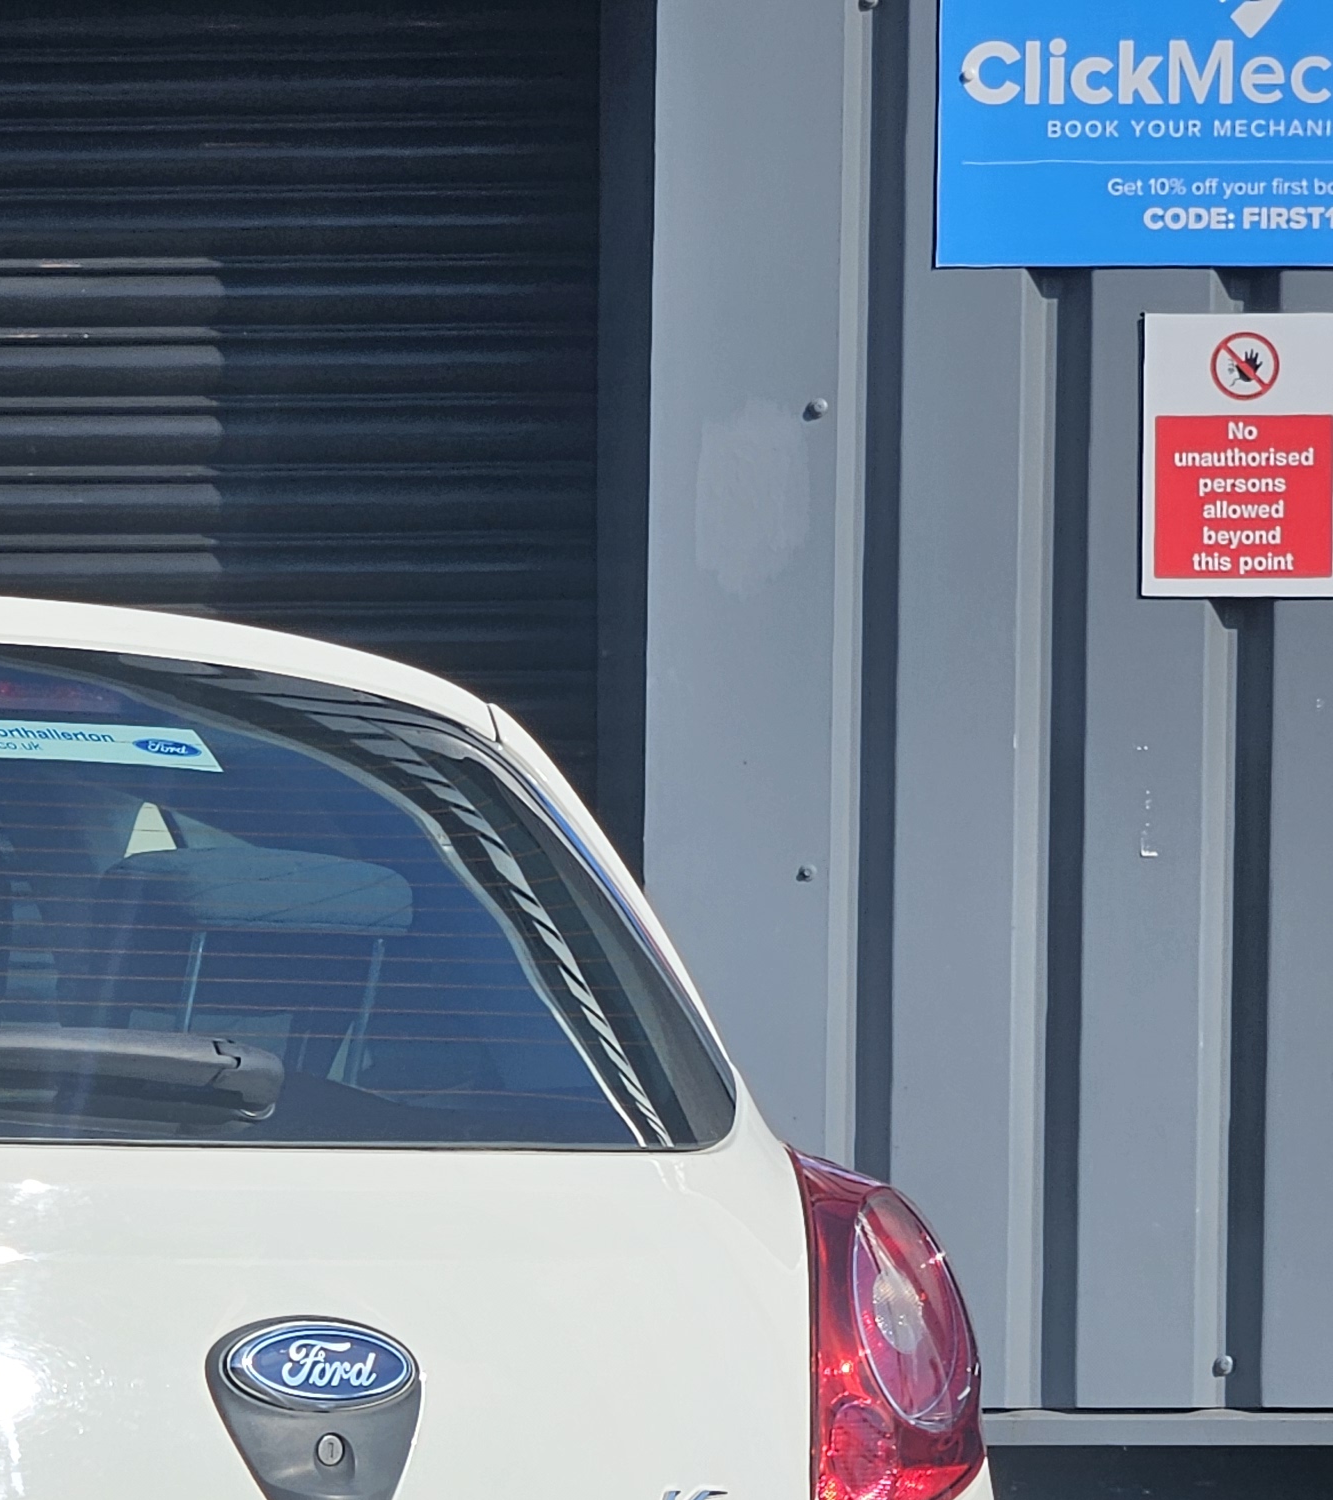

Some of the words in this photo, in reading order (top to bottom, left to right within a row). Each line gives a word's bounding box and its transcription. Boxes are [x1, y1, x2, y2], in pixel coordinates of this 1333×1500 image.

[962, 38, 1332, 105] ClickMec
[1047, 119, 1119, 138] BOOK
[1131, 119, 1202, 138] YOUR
[1213, 119, 1332, 138] MECHANI
[1107, 178, 1144, 196] Get
[1149, 178, 1187, 196] 10%
[1191, 177, 1219, 196] off
[1223, 180, 1267, 200] your
[1272, 177, 1309, 196] first
[1143, 206, 1235, 231] CODE:
[1227, 422, 1258, 441] No
[1174, 447, 1315, 467] unauthorised
[1199, 477, 1286, 497] persons
[1203, 500, 1284, 519] allowed
[1203, 526, 1282, 549] beyond
[1192, 552, 1232, 571] this
[1239, 552, 1294, 575] point
[146, 738, 191, 756] Ford
[281, 1338, 378, 1387] Ford
